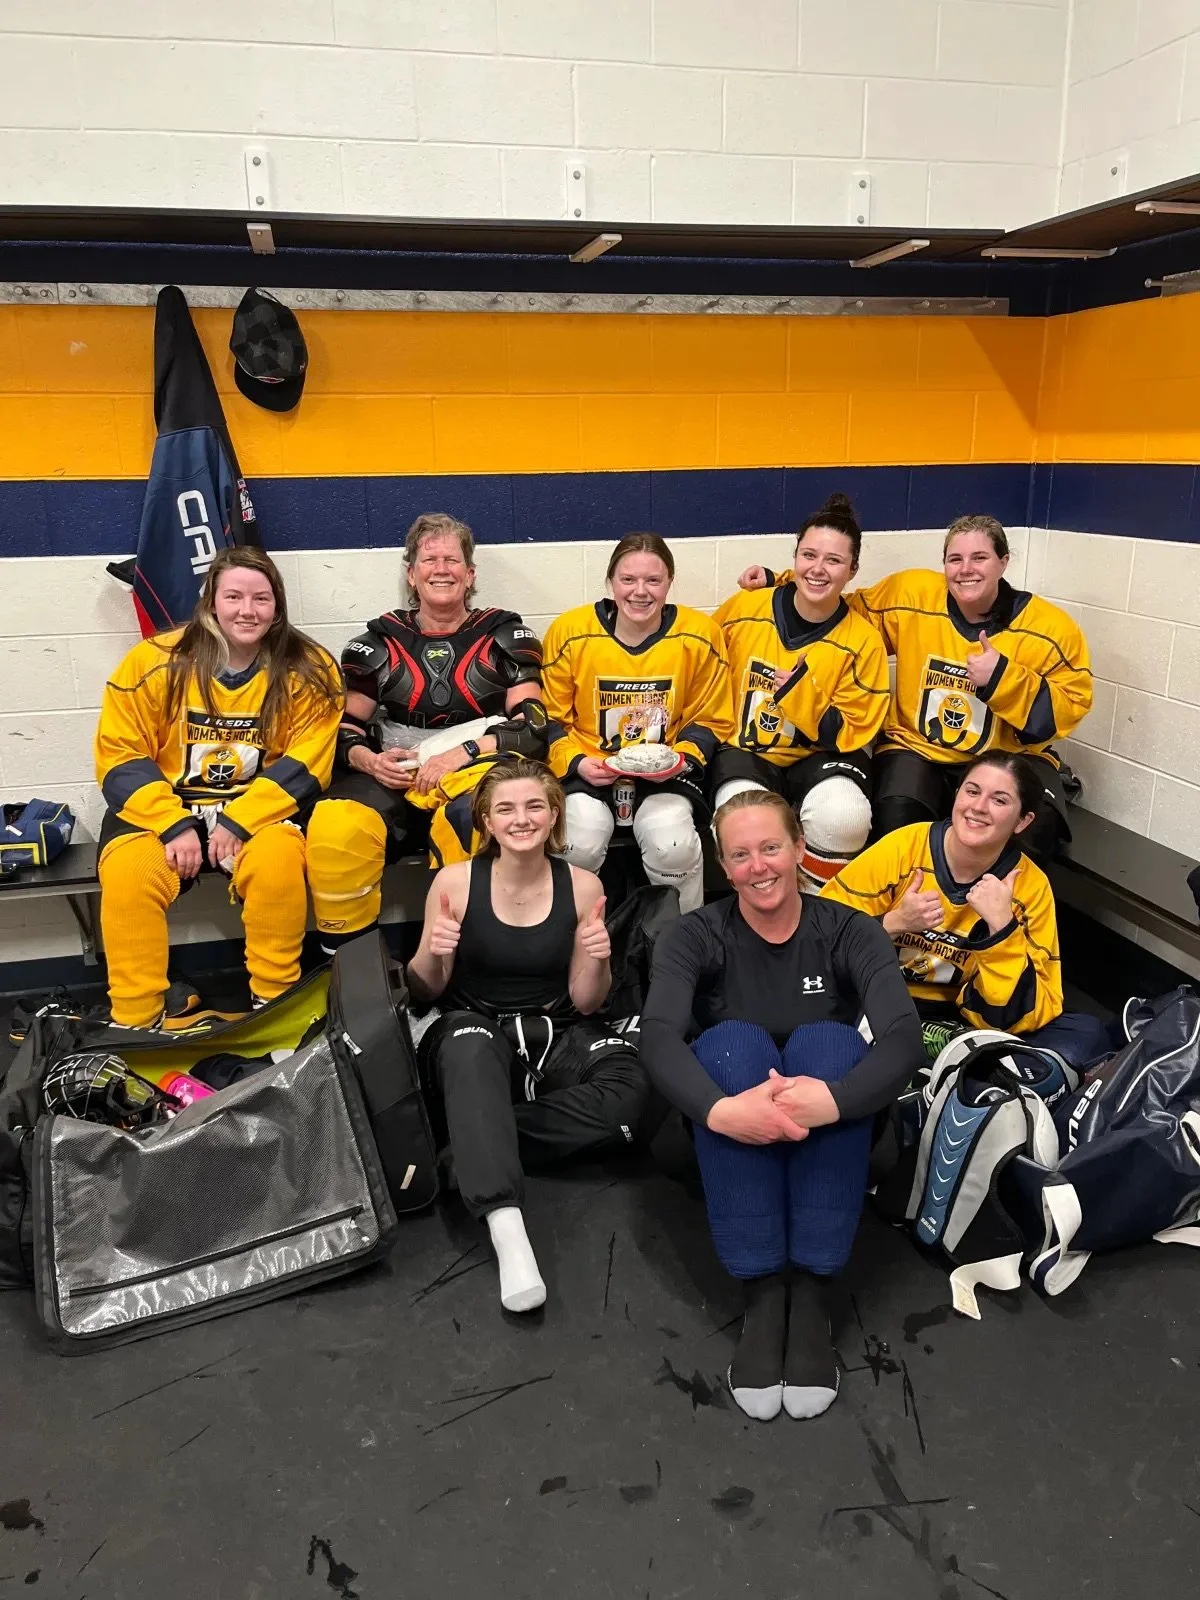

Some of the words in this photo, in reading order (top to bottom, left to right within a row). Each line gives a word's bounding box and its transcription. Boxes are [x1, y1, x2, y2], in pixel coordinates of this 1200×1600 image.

[925, 671, 963, 689] WOMEN'S
[943, 665, 969, 677] PRE
[187, 724, 231, 742] WOMEN'S
[615, 790, 635, 802] Lite
[934, 944, 971, 967] HOCKEY
